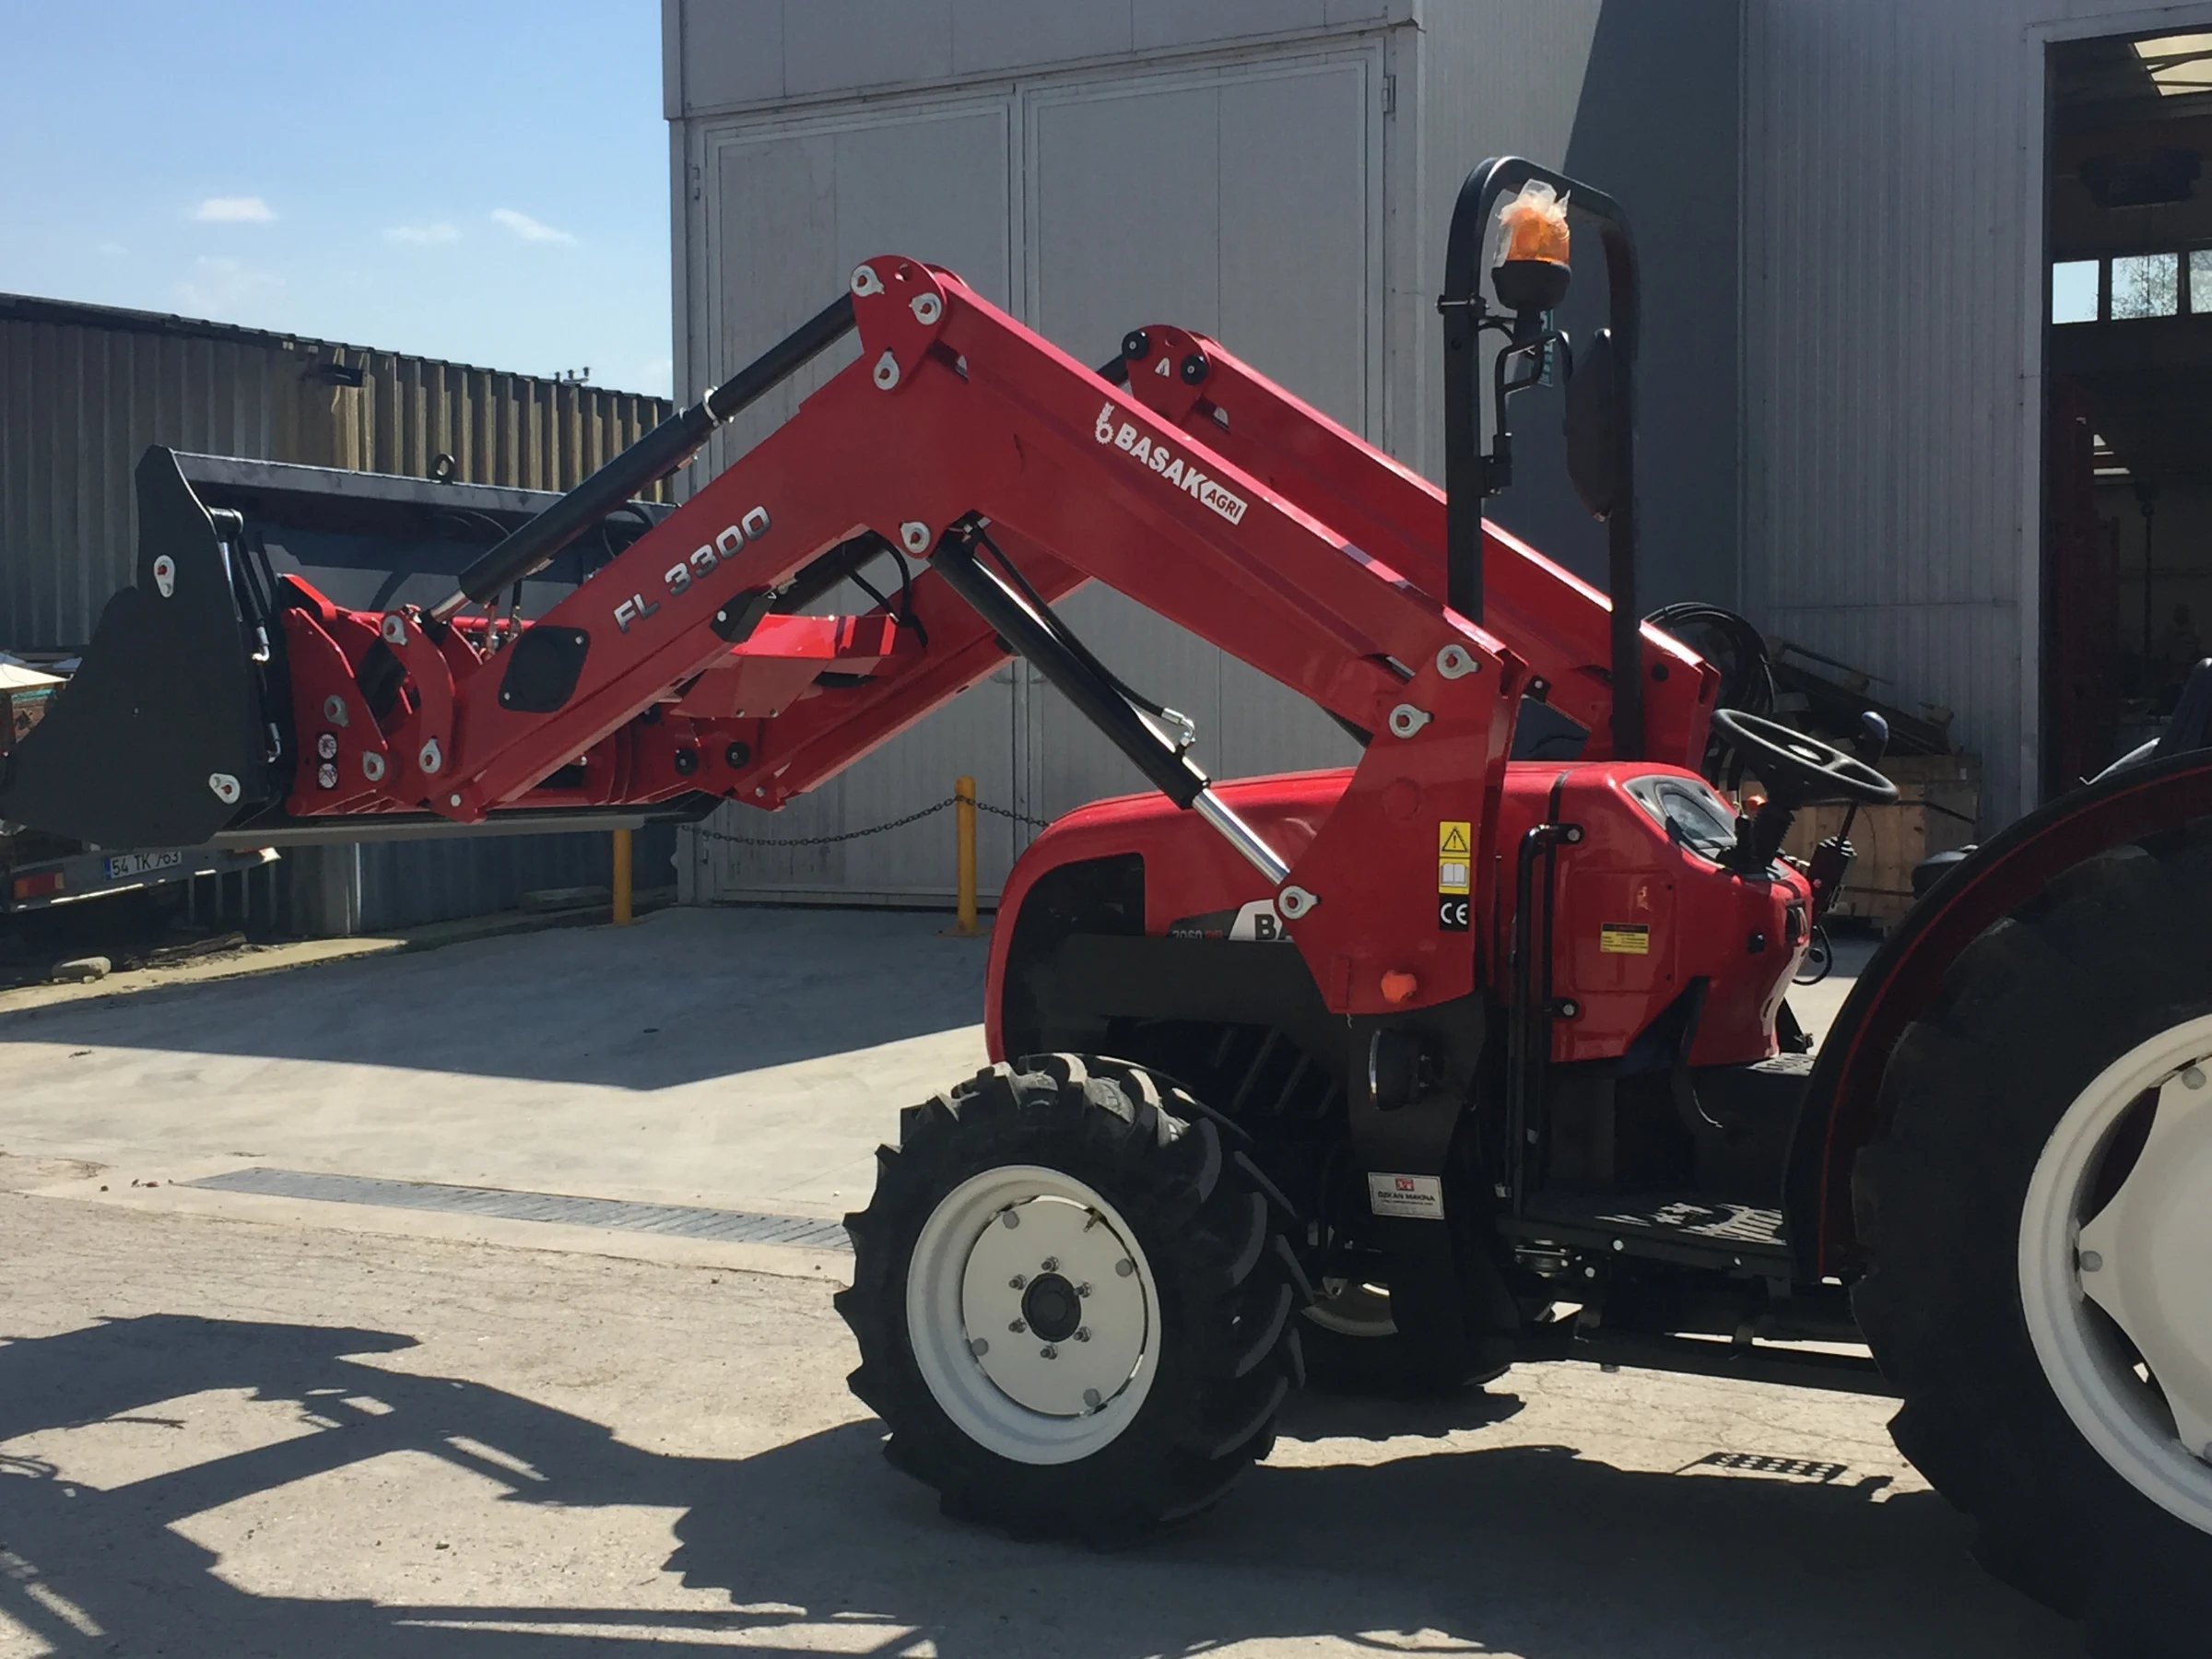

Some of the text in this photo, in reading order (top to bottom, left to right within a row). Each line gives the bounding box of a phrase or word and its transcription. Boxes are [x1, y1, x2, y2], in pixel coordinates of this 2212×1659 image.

[1113, 421, 1242, 518] BASAK AGRI
[613, 505, 771, 634] FL 3300
[112, 857, 129, 876] 54
[134, 853, 151, 871] TK
[1440, 901, 1468, 925] CE
